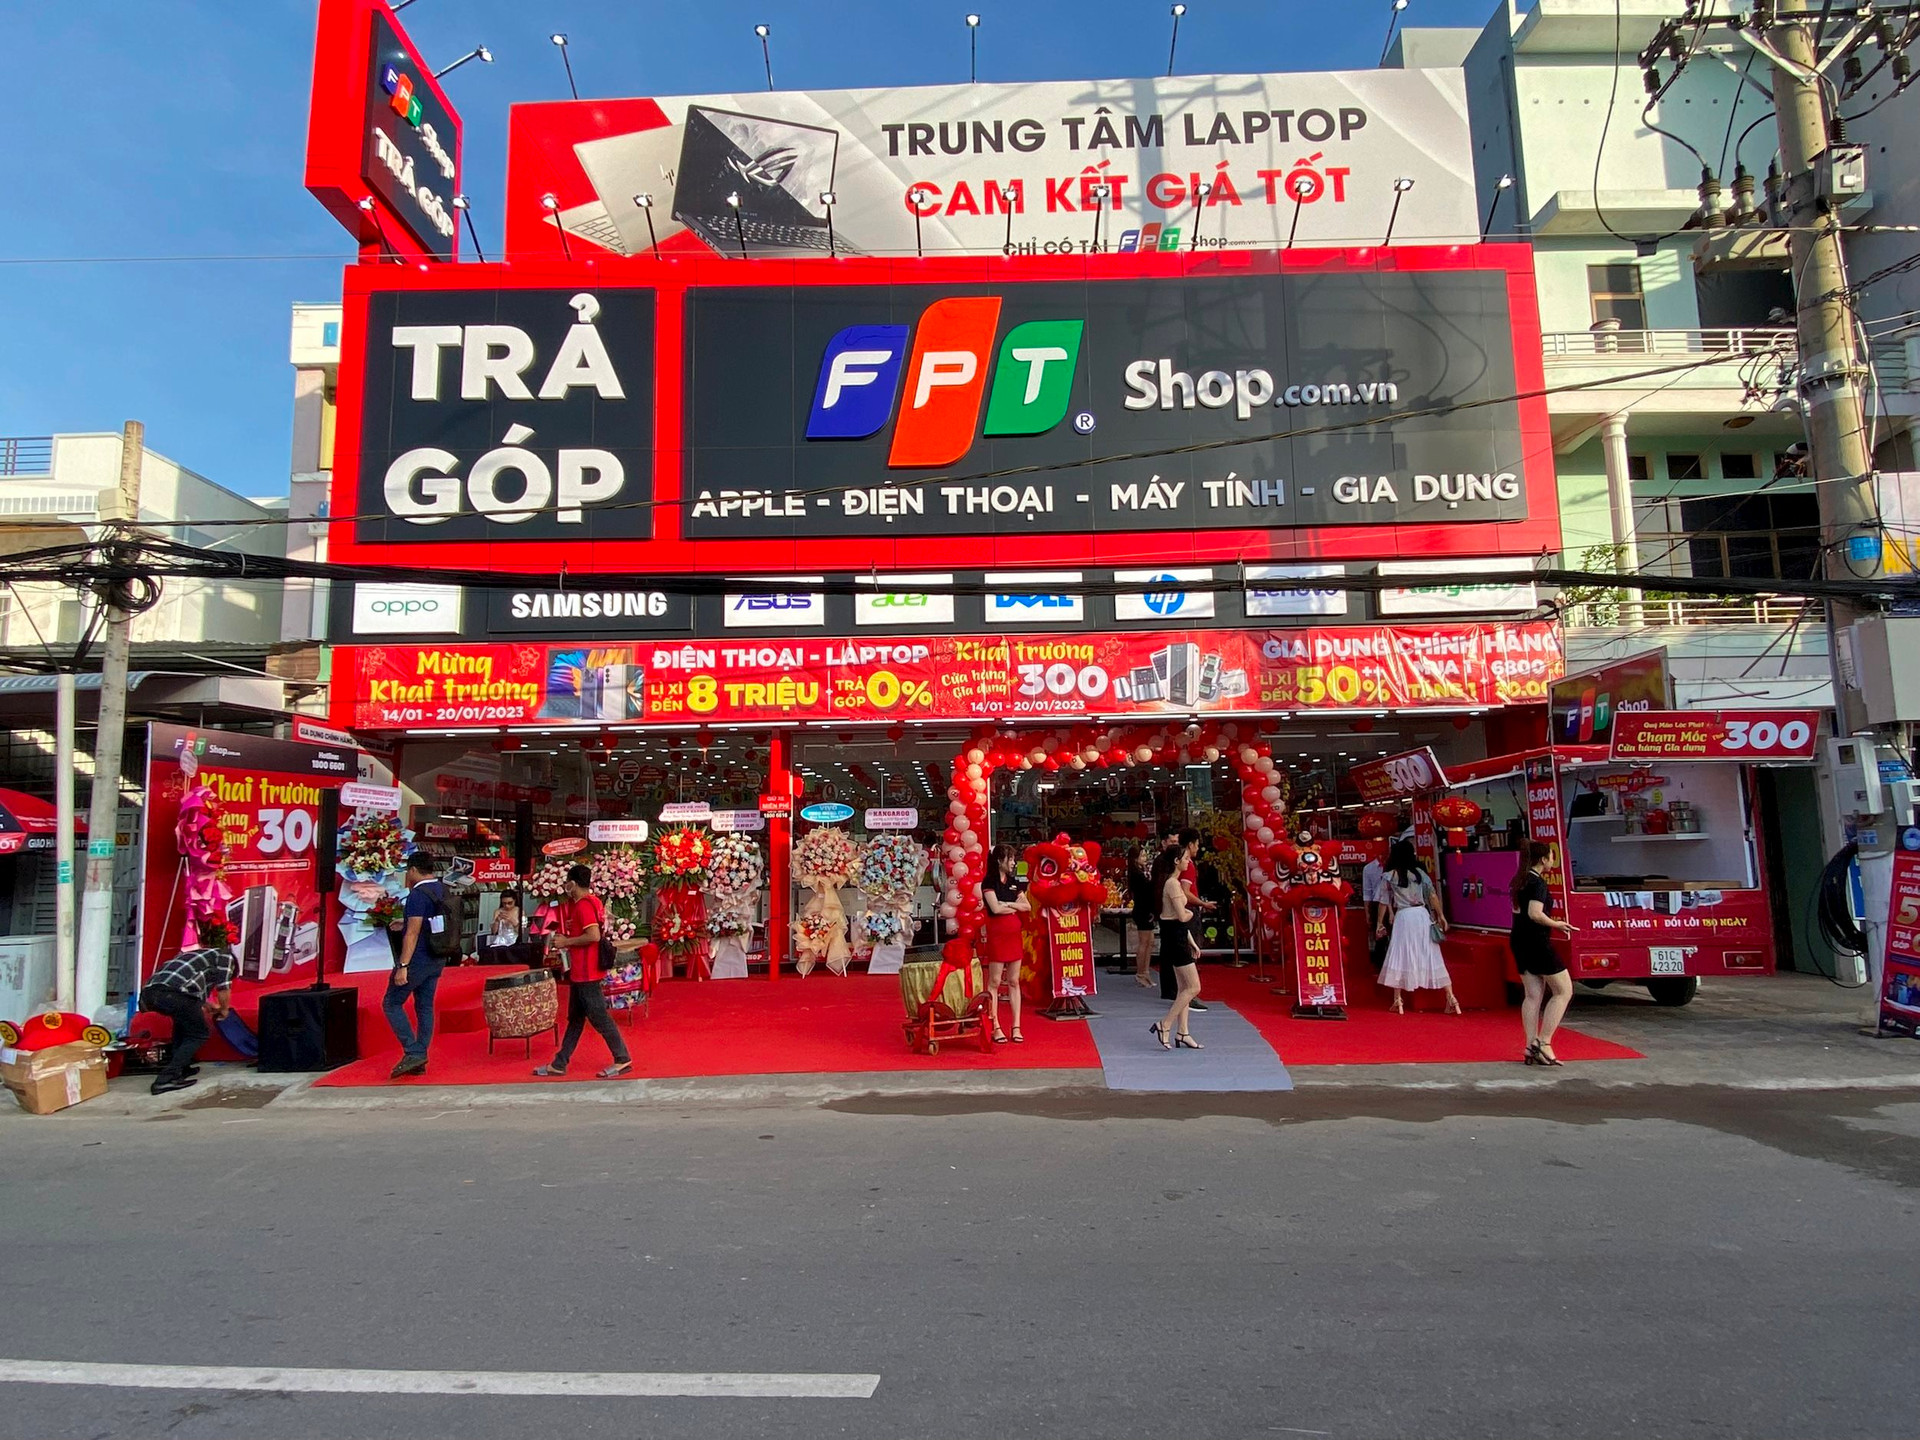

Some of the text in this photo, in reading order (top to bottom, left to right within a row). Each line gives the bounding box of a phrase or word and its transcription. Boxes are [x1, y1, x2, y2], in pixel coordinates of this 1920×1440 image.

[881, 107, 1368, 157] TRUNG TÂM LAPTOP
[904, 151, 1351, 217] CAM KẾT GIÁ TỐT
[1043, 237, 1074, 254] CÓ
[391, 292, 626, 402] TRẢ
[383, 422, 625, 525] GÓP
[691, 471, 1520, 523] APPLE ĐIỆN THOẠI MÁY TÍNH GIA DỤNG
[371, 597, 439, 616] oppo
[511, 591, 669, 619] SAMSUNG
[732, 593, 813, 611] ASUS
[871, 592, 928, 608] acer
[955, 637, 1008, 662] Khai
[1262, 629, 1561, 661] GIA DỤNG CHÍNH HÃNG
[416, 651, 493, 681] Mừng
[652, 645, 929, 673] ĐIỆN THOẠI LAPTOP
[1415, 659, 1460, 676] MUA
[1491, 658, 1546, 676] 6800
[834, 675, 866, 692] TRẢ
[1017, 664, 1108, 697] 300
[369, 678, 539, 707] Khai trương
[651, 674, 820, 713] ĐẾN 8 TRIỆU
[834, 694, 866, 708] GÓP
[1261, 686, 1293, 702] ĐẾN
[971, 699, 1085, 713] 14/01 20/01/2023
[1617, 698, 1649, 711] Shop
[382, 706, 525, 722] 14/01 20/01/2023
[1637, 731, 1676, 745] Chạm
[1720, 721, 1810, 750] 300
[1664, 744, 1680, 752] Gia
[1383, 754, 1433, 793] 300
[200, 772, 254, 802] Khai
[1528, 788, 1555, 802] 6.800
[1532, 802, 1556, 820] SUẤT
[257, 808, 319, 854] 30
[1535, 825, 1556, 837] MUA
[1058, 915, 1079, 928] KHAI
[1304, 922, 1326, 937] ĐẠI
[1592, 920, 1616, 929] MUA
[1617, 920, 1622, 928] 1
[1653, 919, 1658, 928] 1
[1719, 917, 1748, 927] NGÀY
[1054, 931, 1087, 945] TRƯƠNG
[1305, 936, 1330, 951] CÁT
[1306, 955, 1329, 970] ĐẠI
[1657, 951, 1676, 961] 61C
[1062, 963, 1084, 978] PHÁT
[1308, 971, 1329, 987] LỢI
